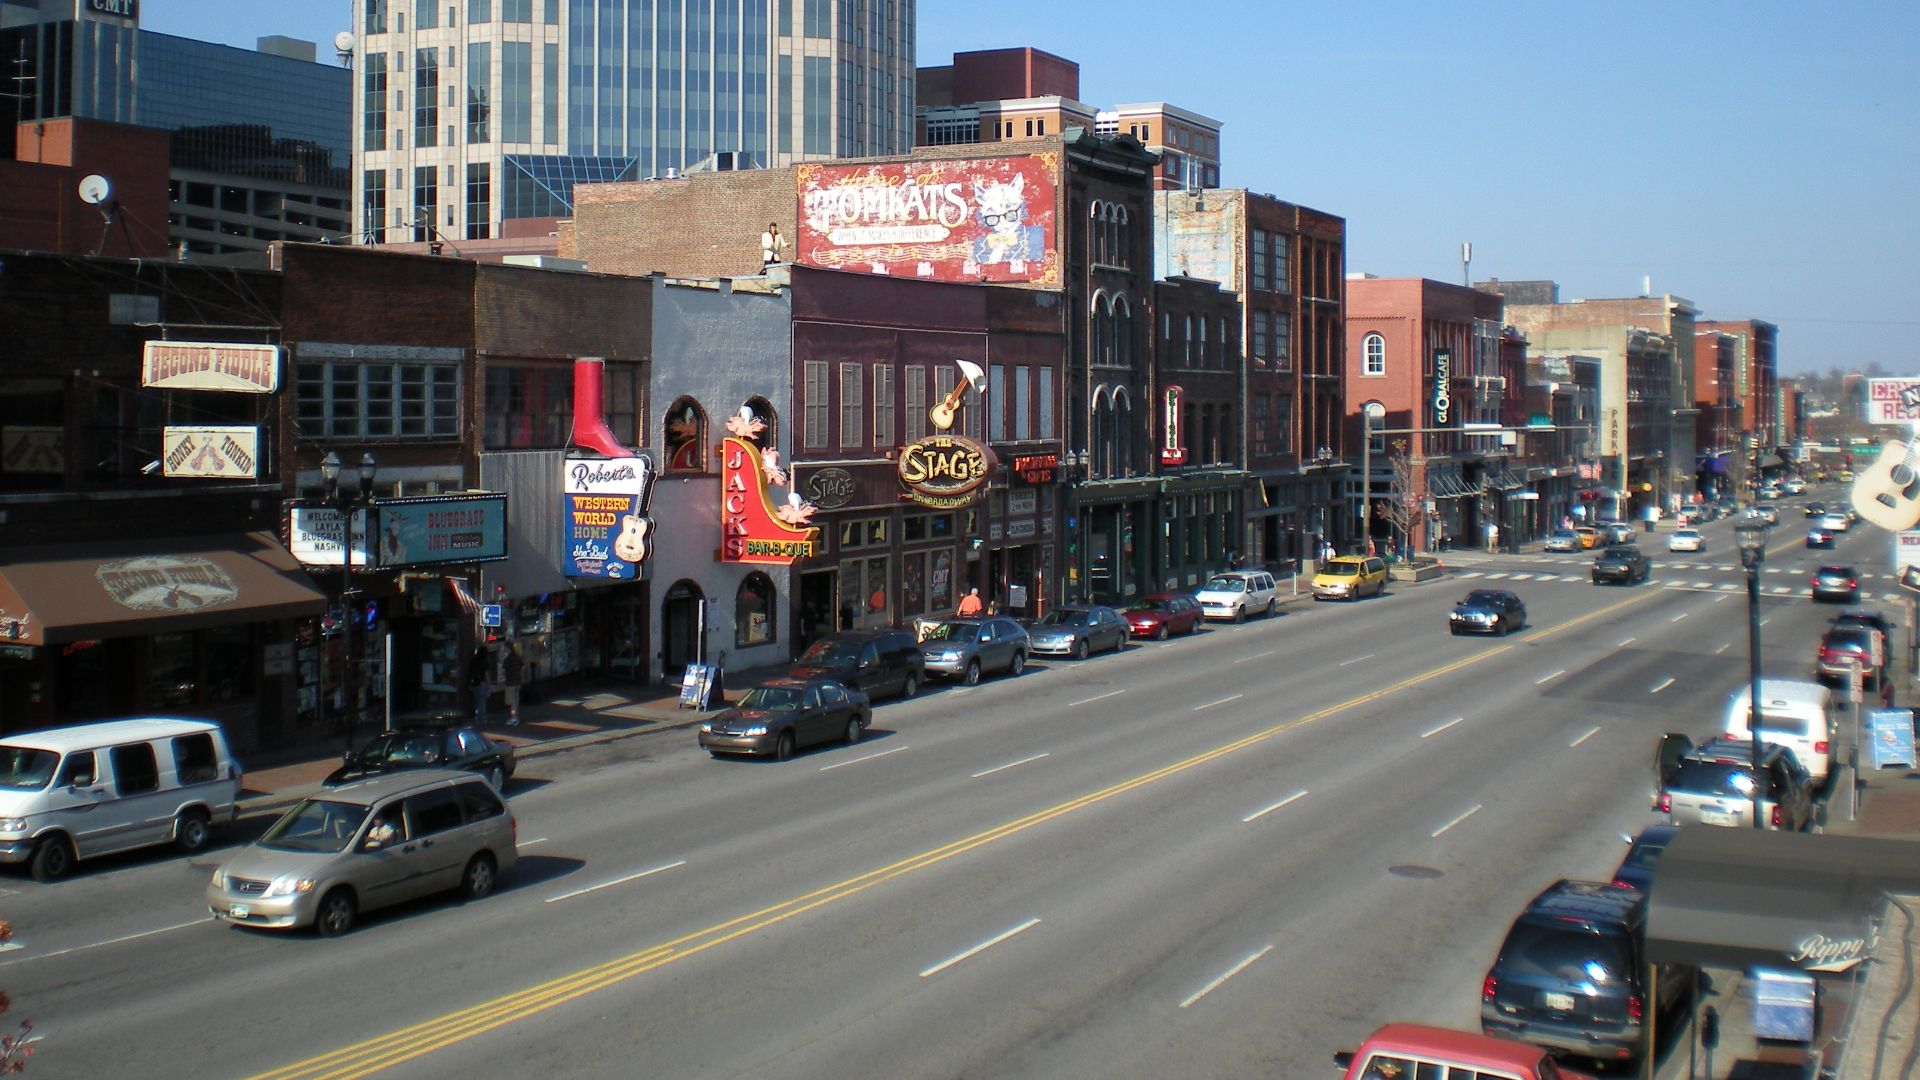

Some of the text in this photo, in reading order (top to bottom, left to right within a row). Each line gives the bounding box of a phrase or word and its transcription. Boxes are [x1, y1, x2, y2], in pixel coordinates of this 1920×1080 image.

[813, 179, 968, 231] TOMKATS
[151, 346, 273, 389] SECOND FIDDLE
[935, 438, 952, 448] THE
[167, 434, 195, 472] HONKY
[905, 444, 985, 482] STAGE
[571, 463, 636, 492] Robert's
[810, 474, 854, 501] STAGE
[573, 496, 630, 511] WESTERN
[726, 450, 749, 557] JACKS
[913, 493, 972, 506] ON BROADWAY
[307, 512, 345, 521] WELCOME
[428, 510, 484, 529] BLUEGRASS
[573, 512, 616, 526] WORLD
[302, 532, 345, 541] BLUEGRAS
[574, 526, 608, 539] HOME
[315, 543, 357, 551] NASHVIE
[453, 541, 480, 549] MUSIC
[746, 541, 809, 556] BAR-B-QUE
[1791, 926, 1880, 964] Rippy's
